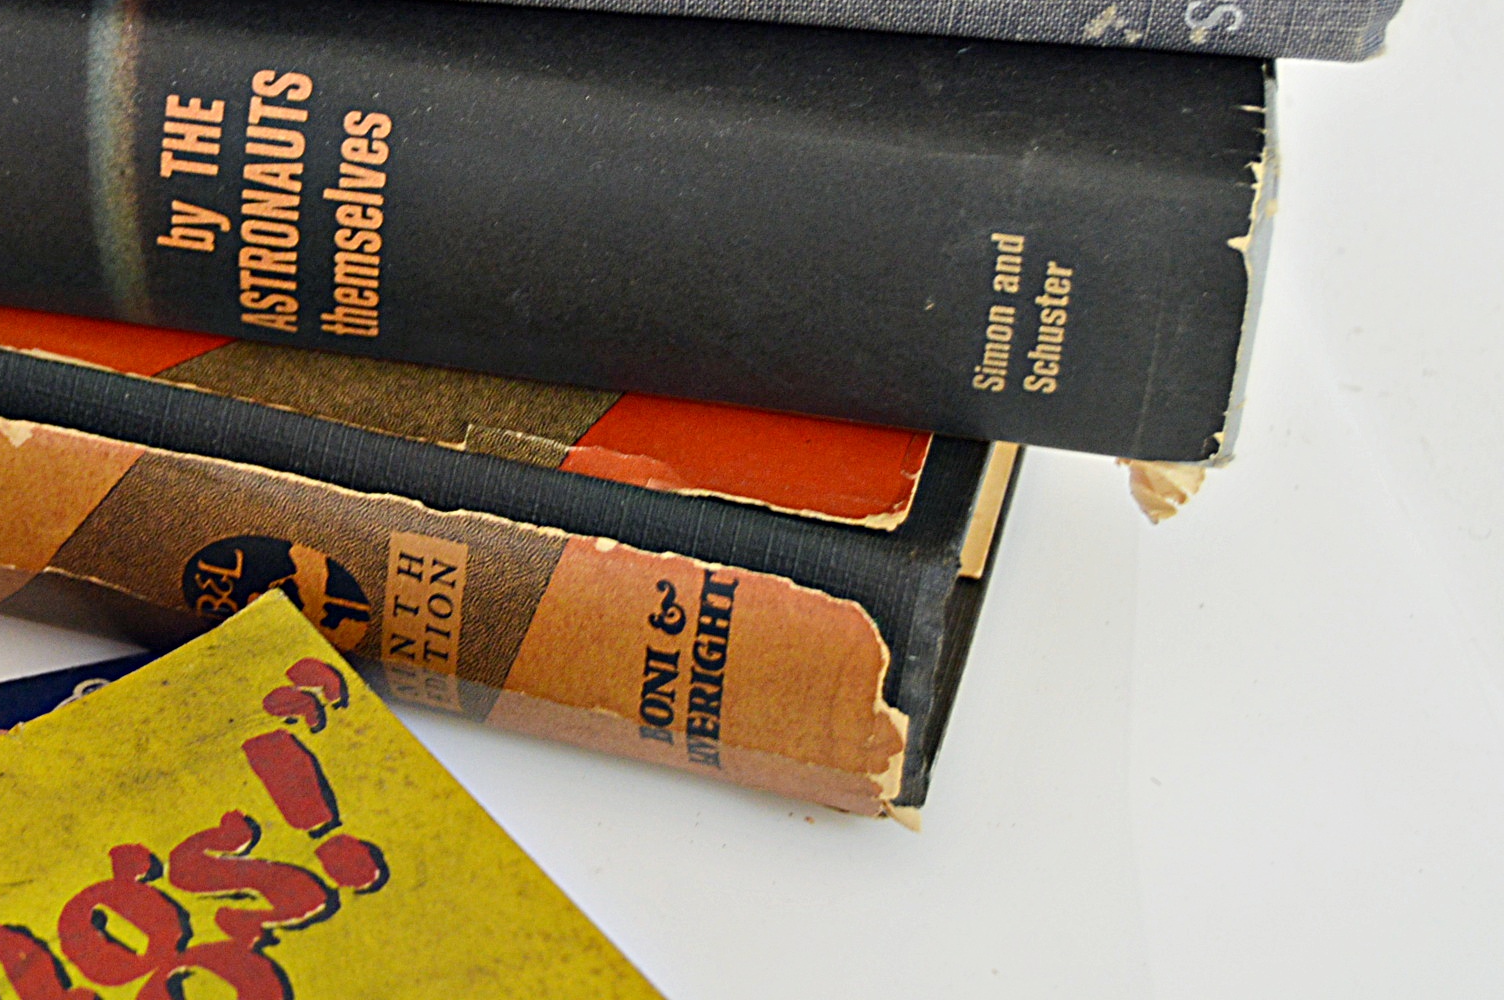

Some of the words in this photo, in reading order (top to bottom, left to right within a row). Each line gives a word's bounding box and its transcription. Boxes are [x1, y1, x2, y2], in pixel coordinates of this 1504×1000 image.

[159, 94, 225, 178] THE
[156, 200, 231, 252] by
[239, 69, 313, 333] ASTRONAUTS
[321, 110, 392, 337] themselves
[991, 232, 1025, 294] and
[972, 305, 1016, 392] Simon
[1023, 261, 1073, 393] Schuster
[649, 580, 687, 635] &
